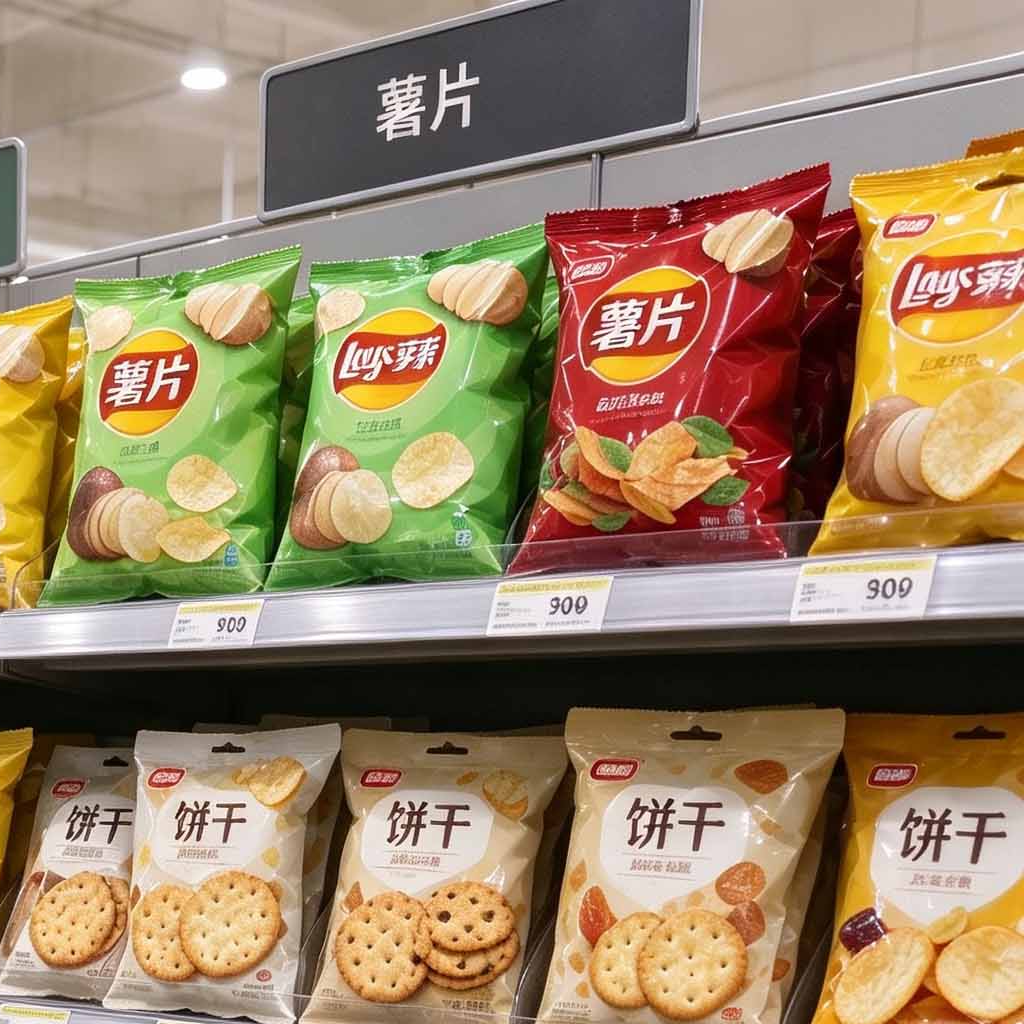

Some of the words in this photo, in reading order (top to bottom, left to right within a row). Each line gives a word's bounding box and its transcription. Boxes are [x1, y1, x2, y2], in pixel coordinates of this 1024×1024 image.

[376, 62, 480, 142] 薯片
[592, 292, 695, 351] 薯片
[104, 355, 190, 406] 薯片
[66, 804, 133, 844] 饼干
[175, 800, 247, 844] 饼干
[387, 800, 470, 848] 饼干
[627, 797, 725, 852] 饼干
[901, 808, 1007, 865] 饼干
